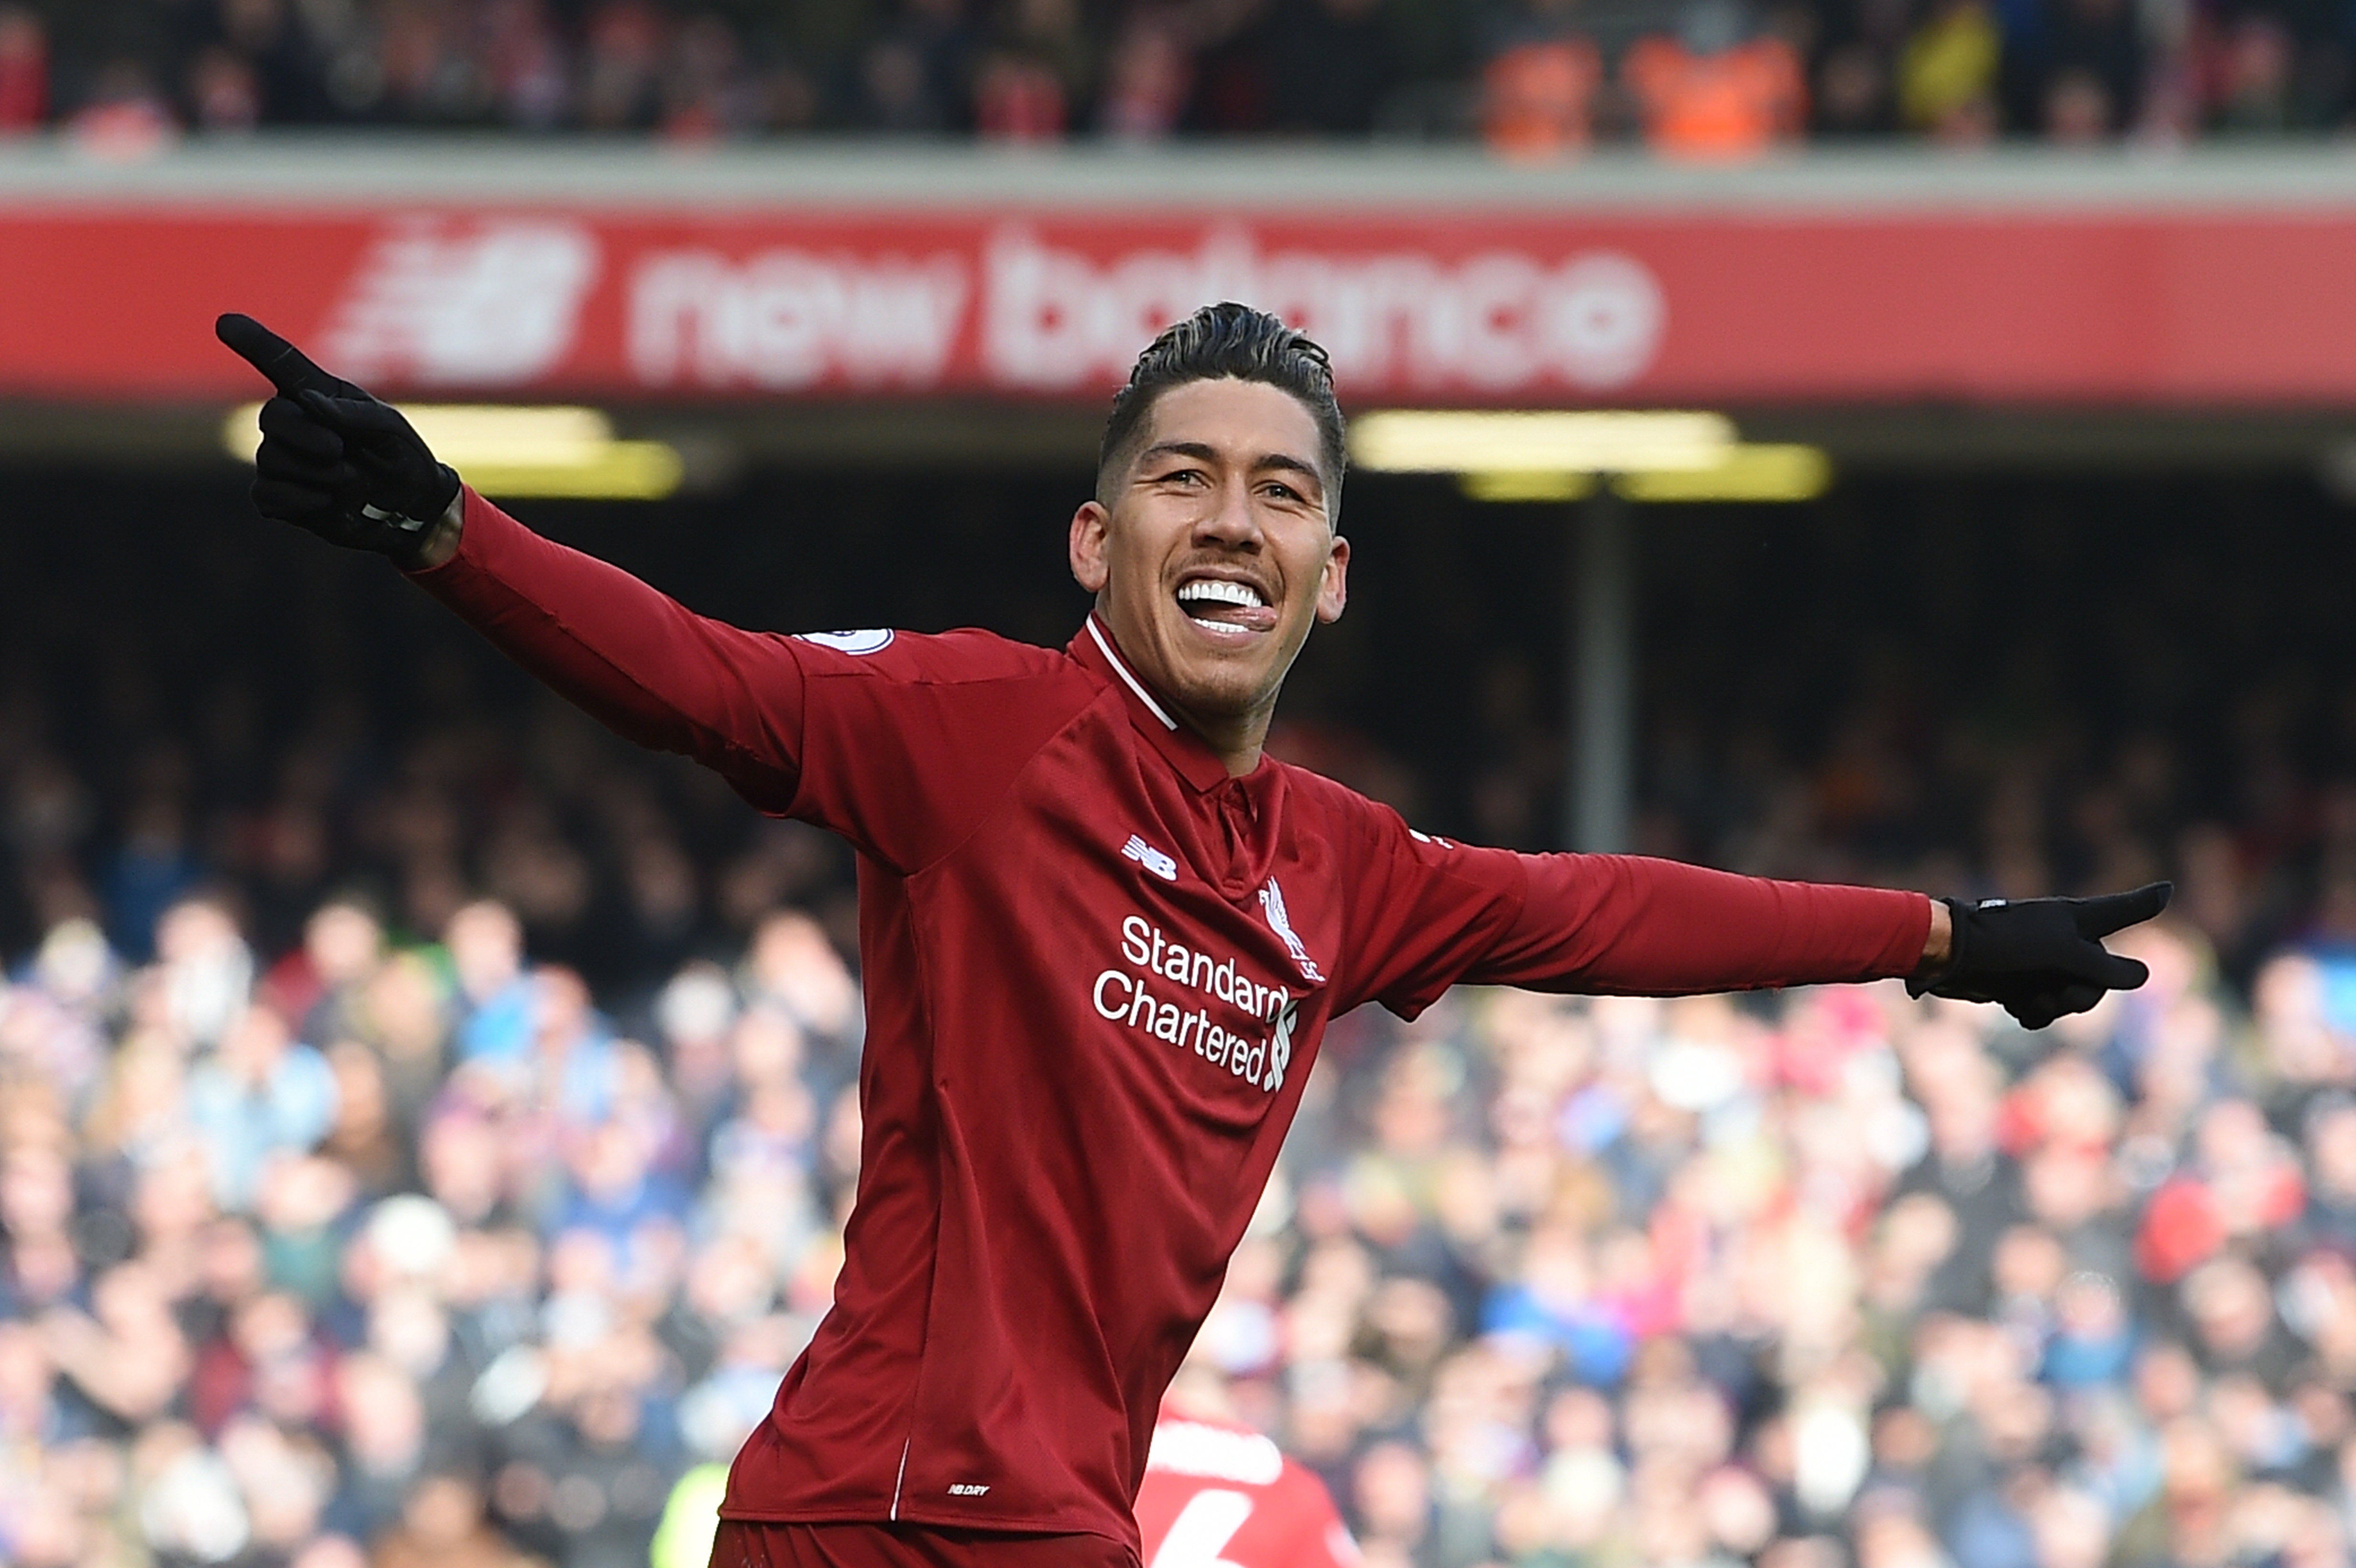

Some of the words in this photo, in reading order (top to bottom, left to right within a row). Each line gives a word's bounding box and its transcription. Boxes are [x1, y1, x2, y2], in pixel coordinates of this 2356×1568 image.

[627, 249, 966, 388] new
[1122, 915, 1289, 1024] Standard
[1094, 970, 1267, 1085] Chartered
